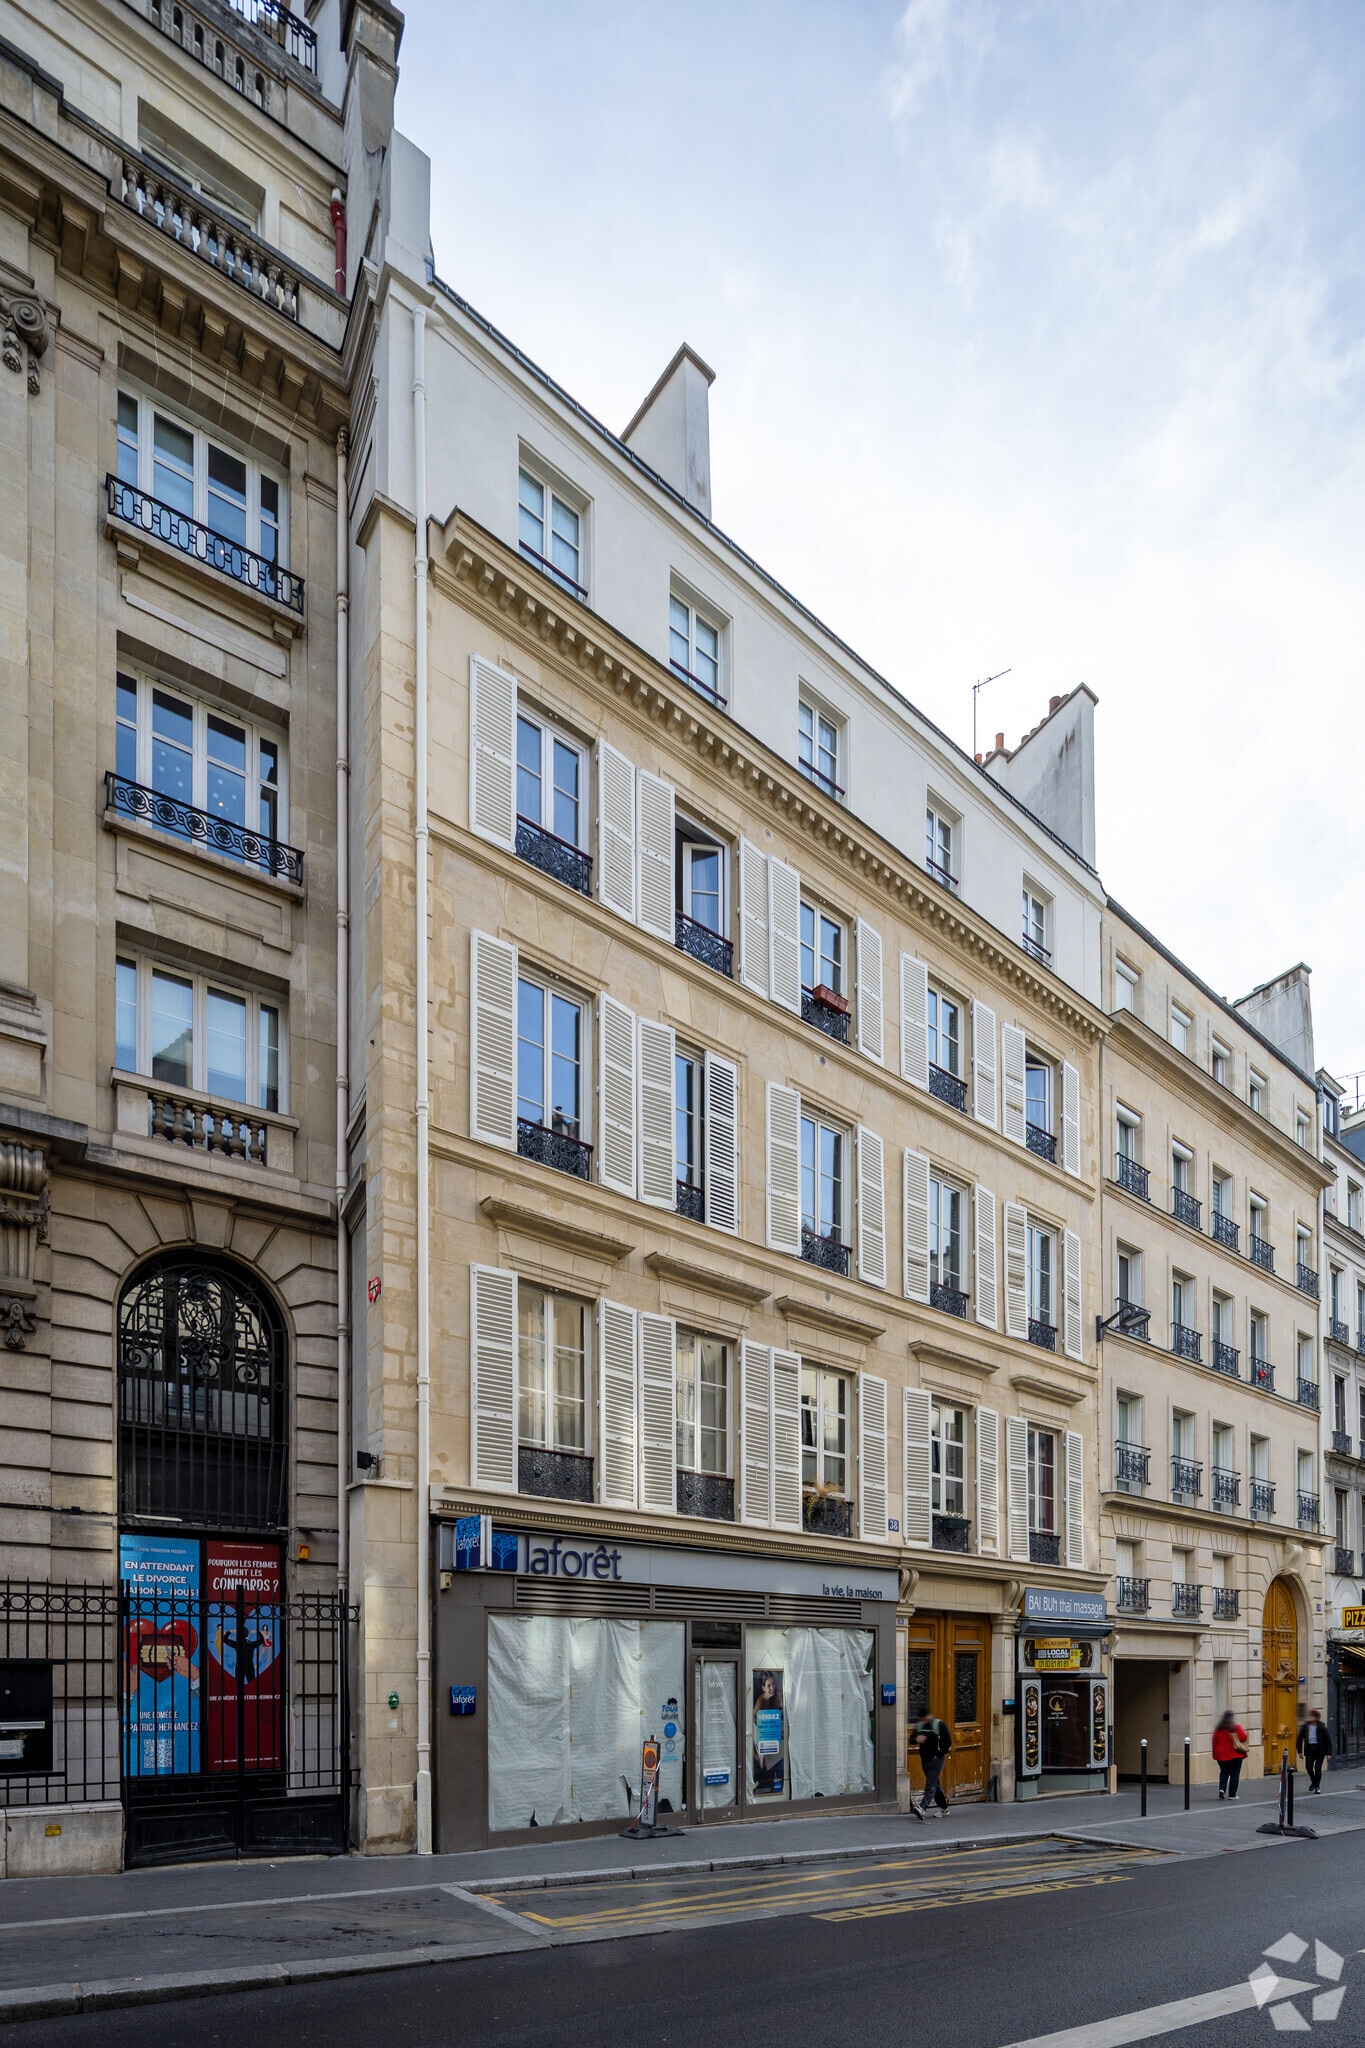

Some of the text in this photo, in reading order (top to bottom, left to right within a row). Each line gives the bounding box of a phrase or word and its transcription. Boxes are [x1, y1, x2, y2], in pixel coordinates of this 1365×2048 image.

[890, 1520, 897, 1530] 38
[456, 1535, 479, 1550] laforêt
[525, 1535, 622, 1580] laforêt
[125, 1561, 195, 1572] EN ATTENDANT
[208, 1559, 238, 1567] POURQUOI
[239, 1560, 251, 1568] LES
[224, 1568, 249, 1576] AIMENT
[133, 1574, 187, 1584] LE DIVORCE
[273, 1579, 279, 1592] ?
[822, 1583, 882, 1599] la vie, la maison
[1029, 1595, 1102, 1618] BAI BUN thai massage
[453, 1695, 475, 1703] laforêt
[662, 1704, 678, 1712] Tous
